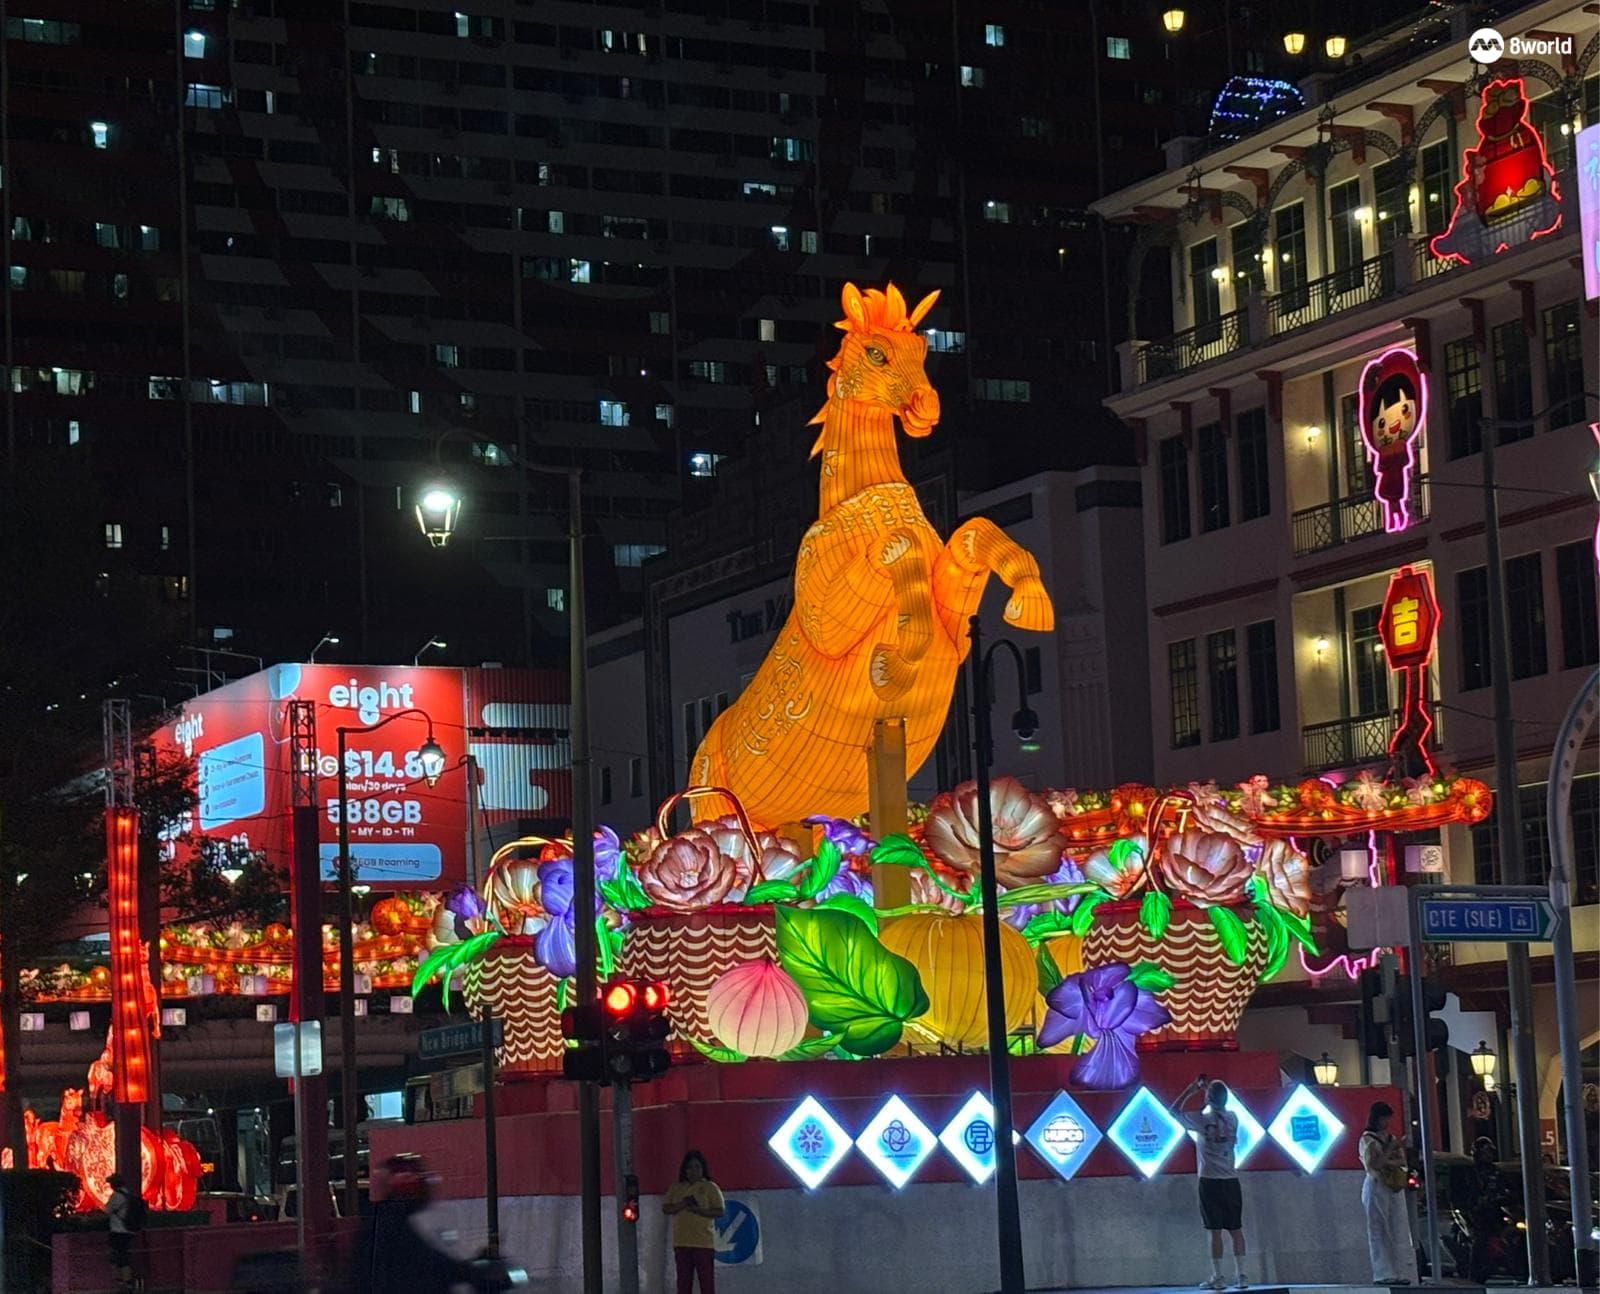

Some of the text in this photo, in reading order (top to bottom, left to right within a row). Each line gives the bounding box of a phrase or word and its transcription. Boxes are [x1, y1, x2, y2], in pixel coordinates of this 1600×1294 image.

[1391, 596, 1419, 646] 吉
[328, 678, 414, 725] eight
[174, 713, 204, 757] eight
[345, 780, 380, 792] lan/30
[327, 798, 422, 824] 588GB
[358, 827, 374, 836] MY
[382, 827, 393, 836] ID
[401, 827, 414, 836] TH
[1429, 908, 1502, 929] CTE (SLE)
